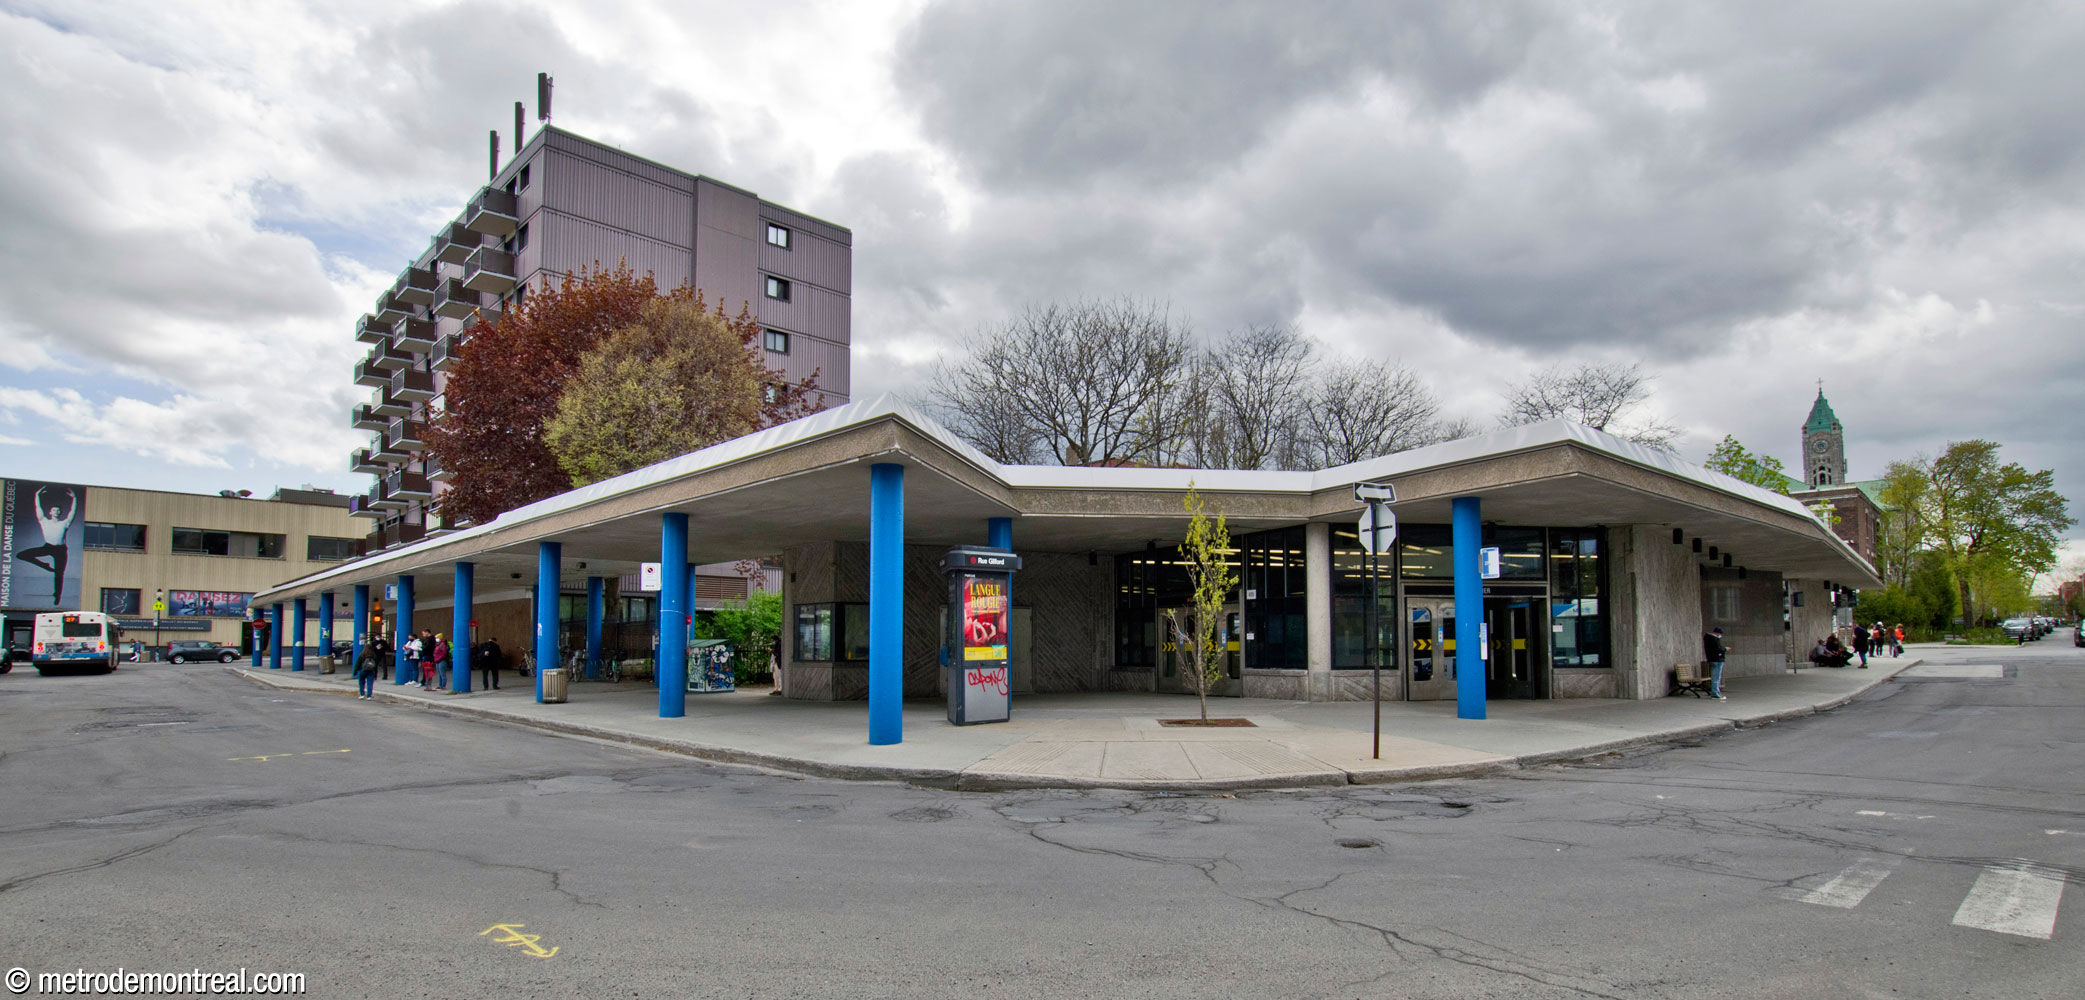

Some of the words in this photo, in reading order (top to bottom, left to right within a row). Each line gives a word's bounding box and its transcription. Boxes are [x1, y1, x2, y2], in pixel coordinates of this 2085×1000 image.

[5, 480, 16, 511] QUÉBEC
[5, 511, 14, 524] DU
[3, 525, 14, 551] DANSE
[3, 552, 12, 563] LA
[2, 563, 11, 575] DE
[0, 576, 10, 607] MAISON
[970, 583, 1001, 596] LANGUE
[176, 591, 241, 603] DANSEZ
